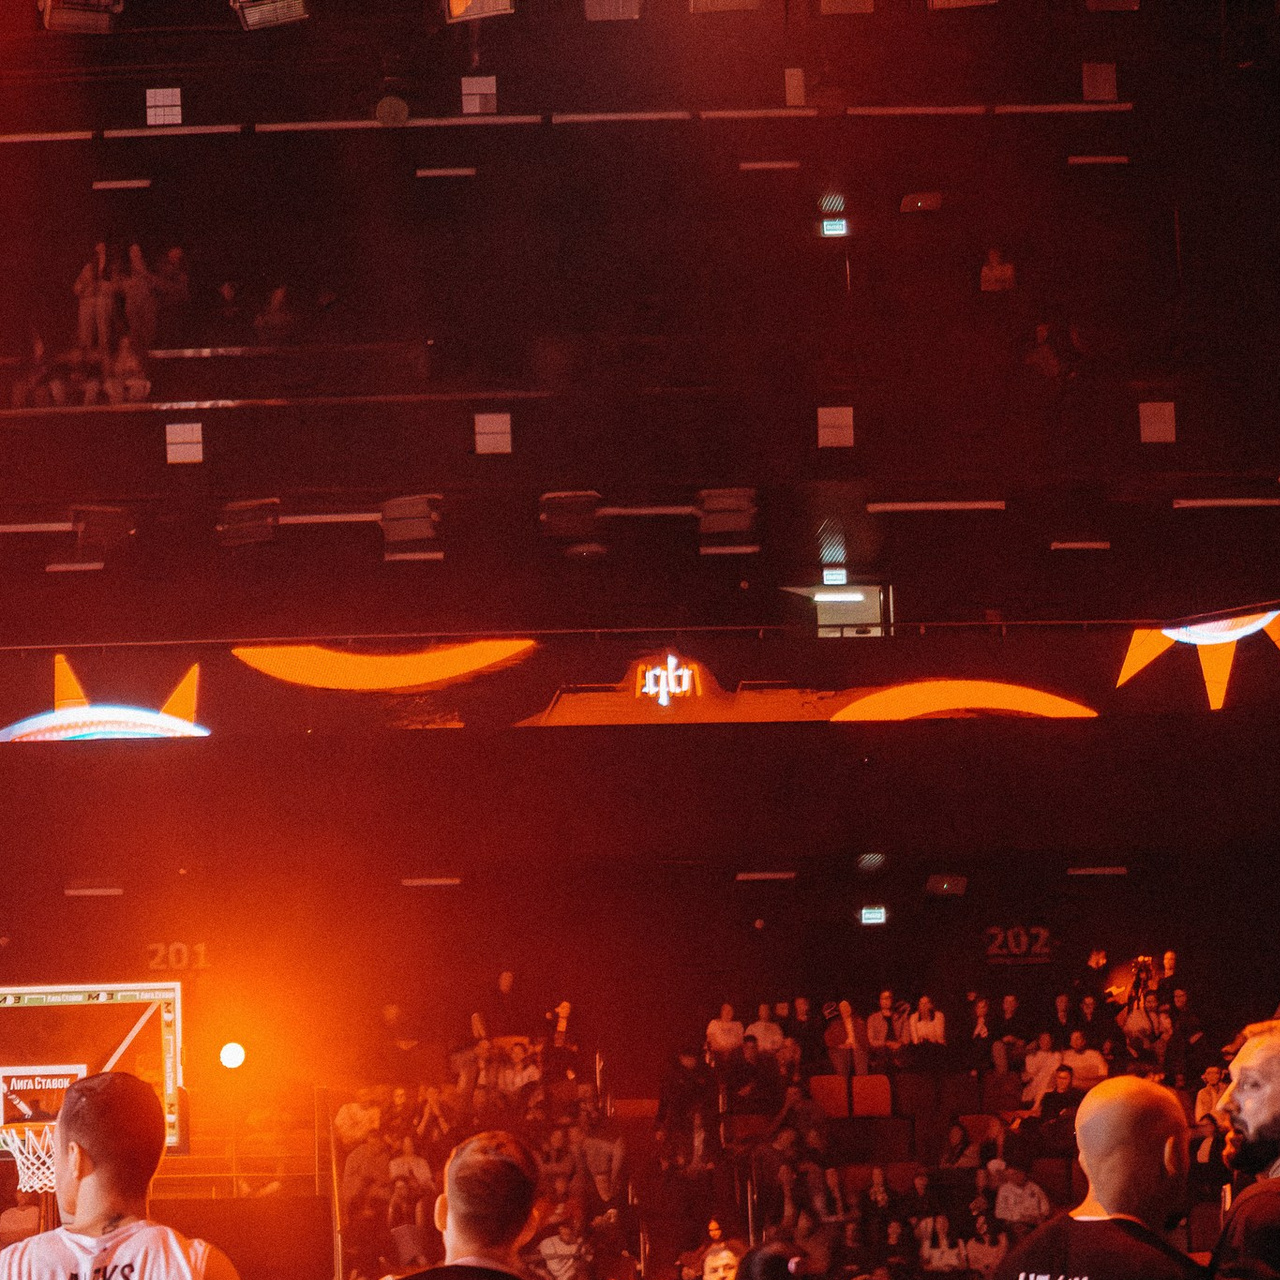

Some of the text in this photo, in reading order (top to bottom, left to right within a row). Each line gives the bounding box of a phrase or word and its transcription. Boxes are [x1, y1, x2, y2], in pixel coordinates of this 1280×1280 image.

[986, 925, 1050, 955] 202
[147, 941, 210, 970] 201
[10, 1078, 34, 1091] ЛИГА
